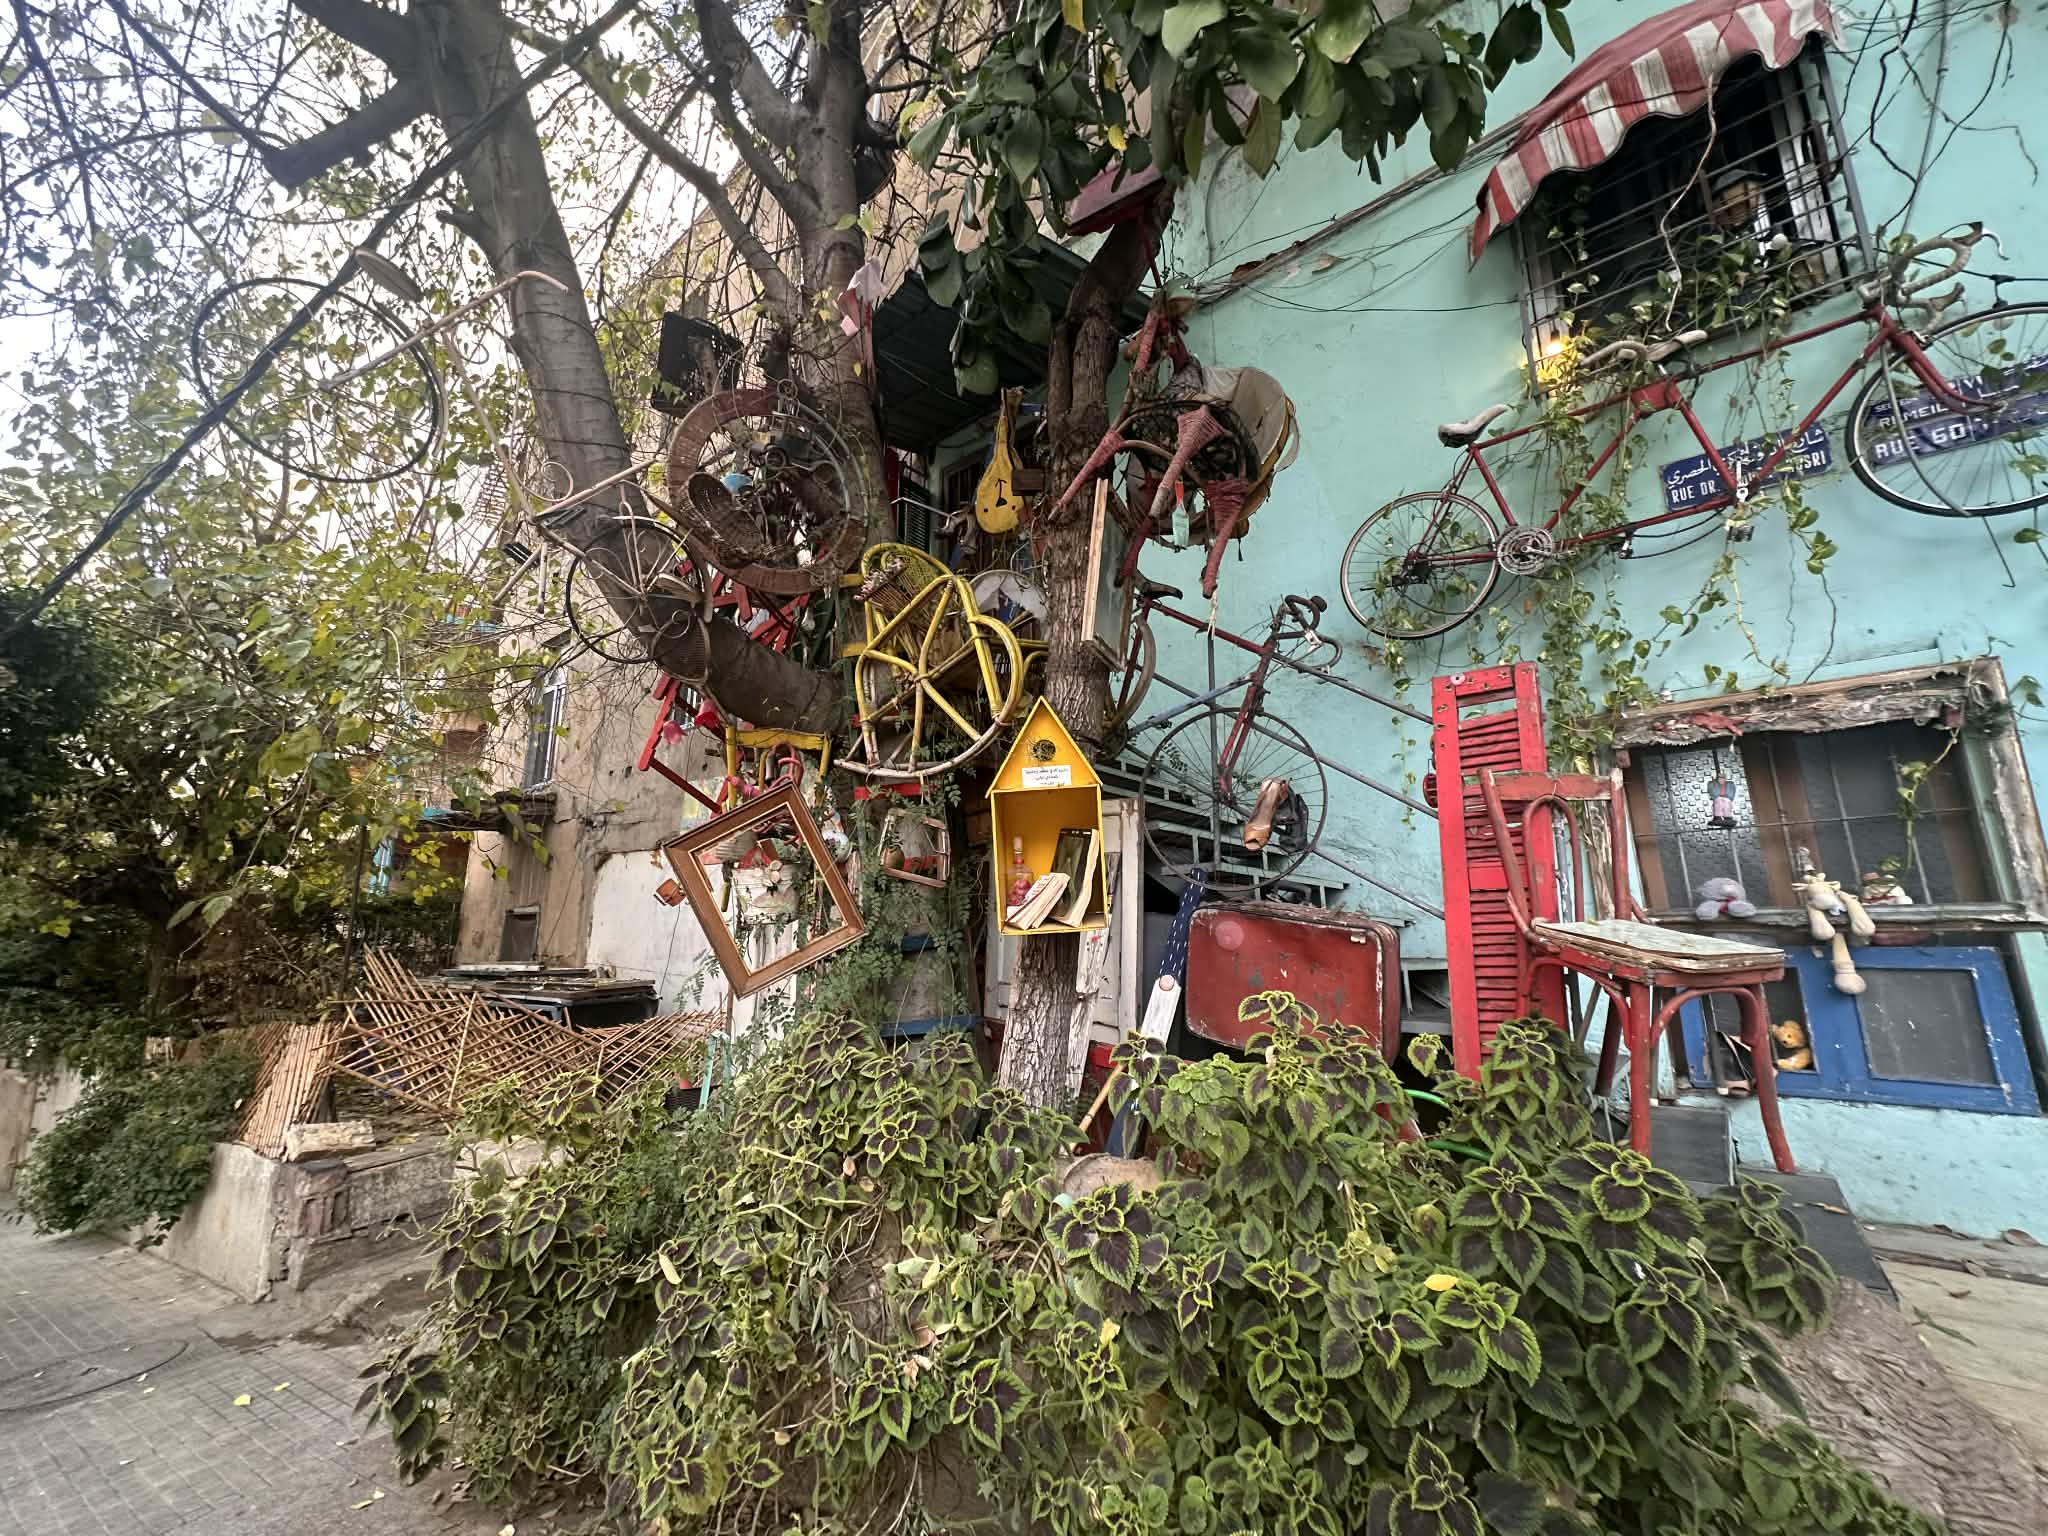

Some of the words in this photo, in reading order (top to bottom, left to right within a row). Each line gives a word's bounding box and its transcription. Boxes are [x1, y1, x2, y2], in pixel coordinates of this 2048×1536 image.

[1874, 430, 1920, 459] RUE
[1931, 423, 1966, 444] 60
[1671, 485, 1696, 503] RUE
[1699, 480, 1721, 496] DR.
